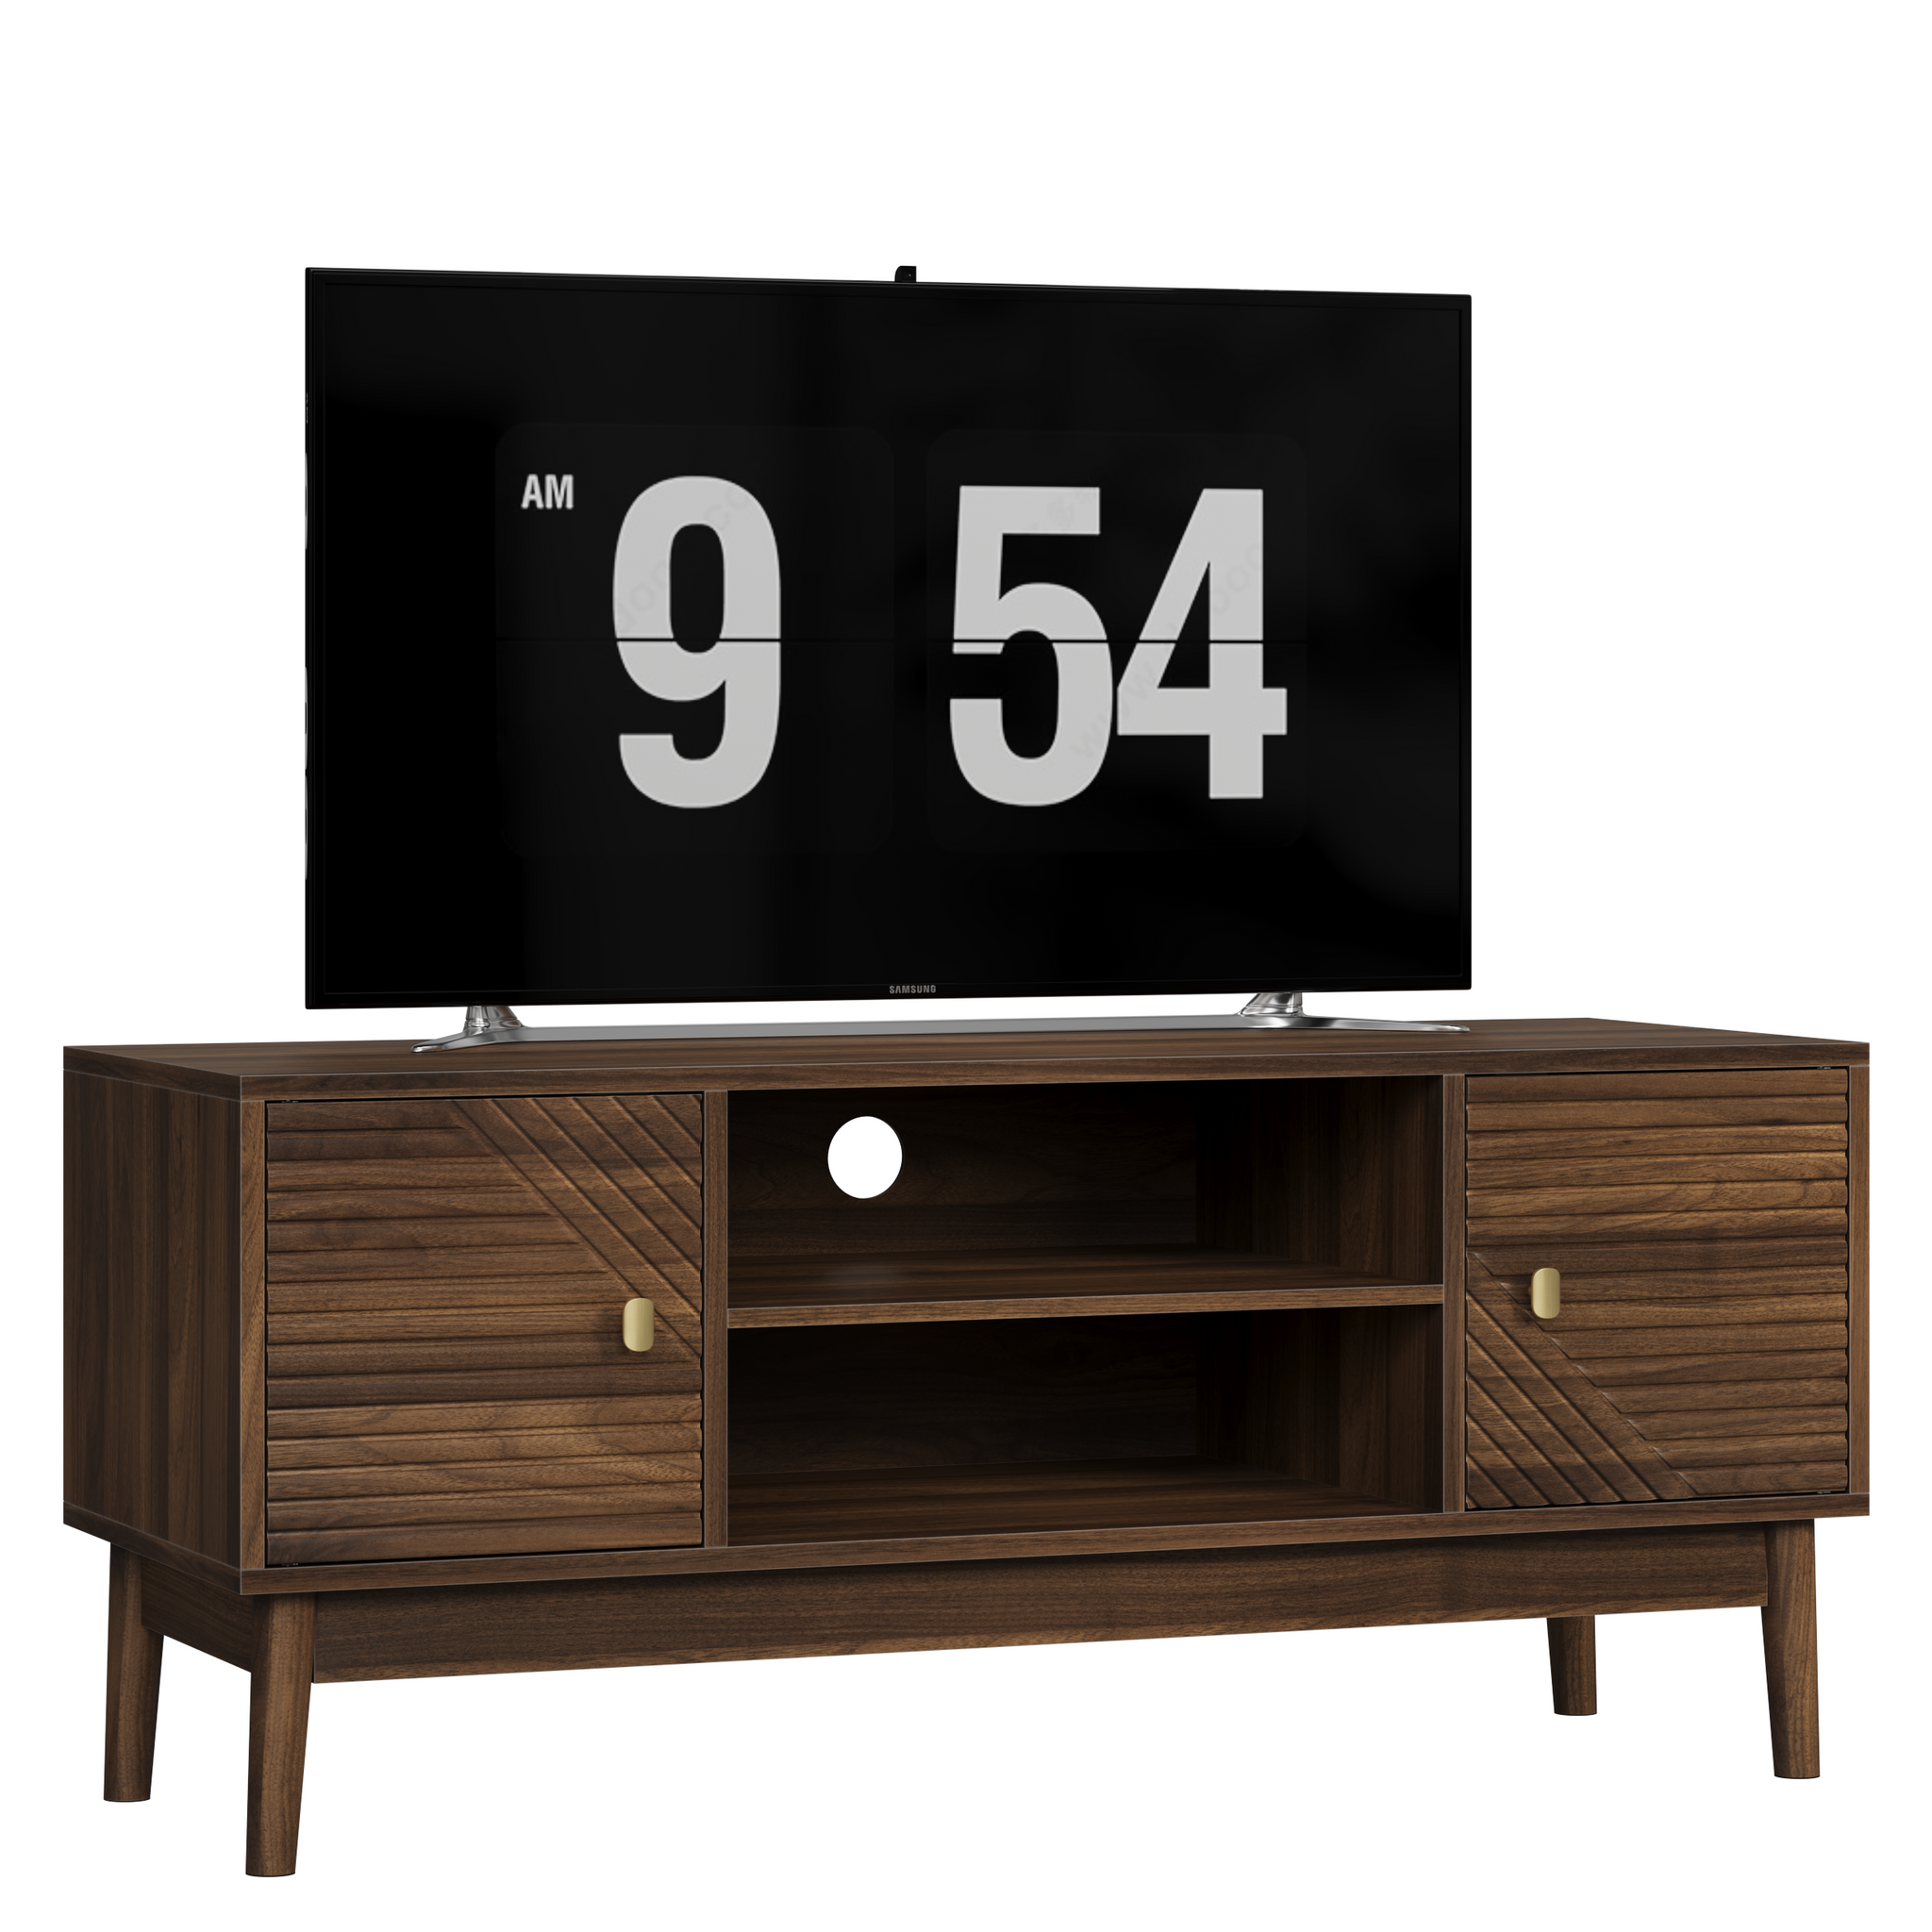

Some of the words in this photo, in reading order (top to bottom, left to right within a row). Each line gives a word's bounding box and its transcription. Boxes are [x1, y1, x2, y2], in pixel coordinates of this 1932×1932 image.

[521, 474, 574, 509] AM
[613, 476, 781, 809] 9
[949, 485, 1287, 807] 54
[889, 984, 937, 994] SAMSUNG
